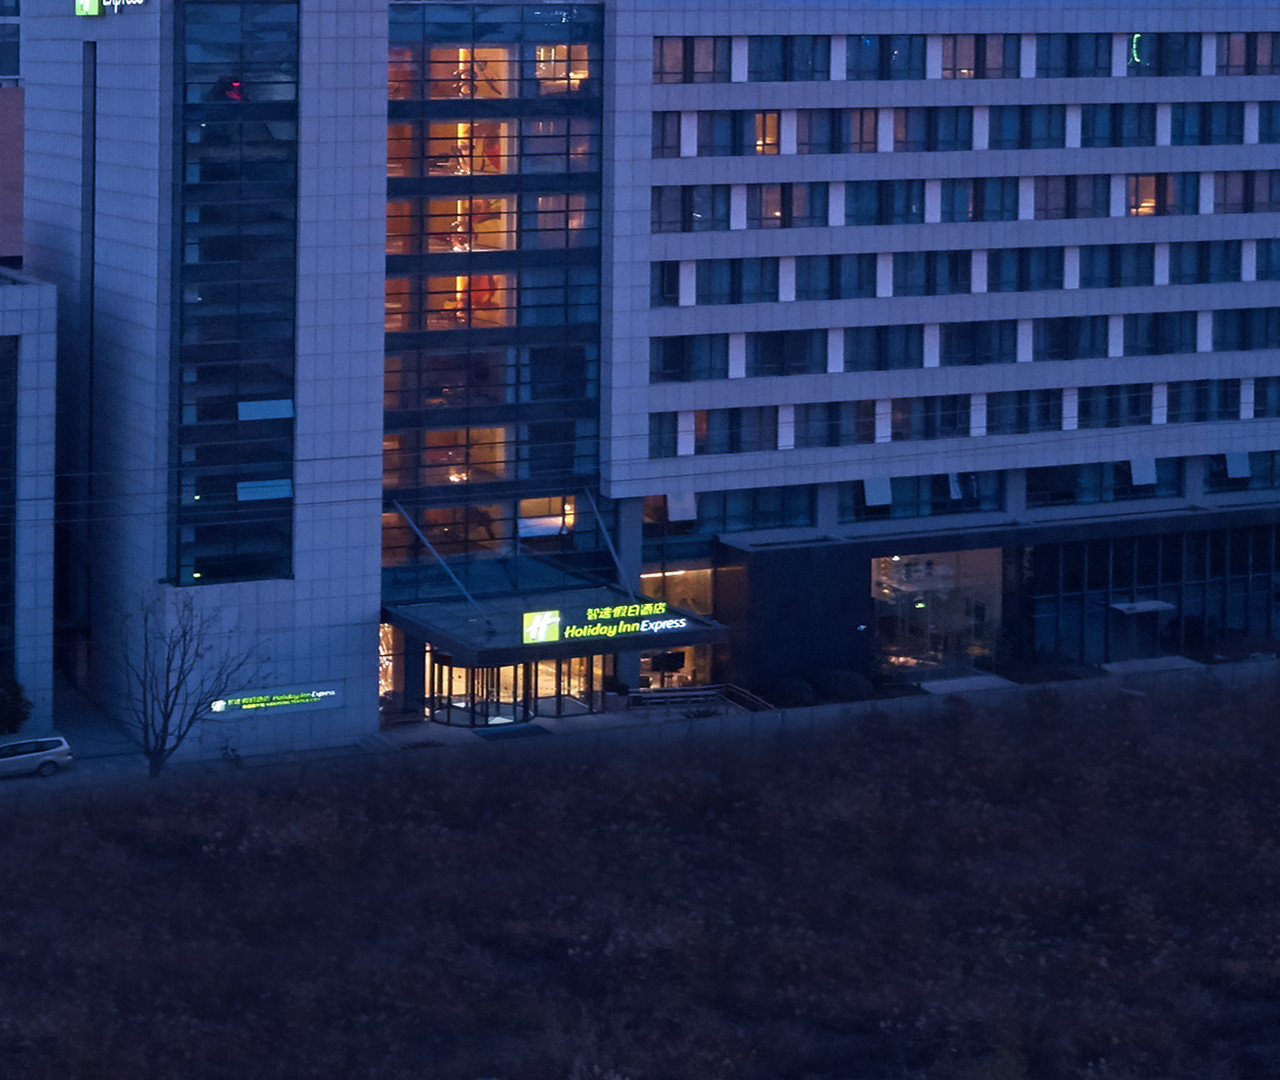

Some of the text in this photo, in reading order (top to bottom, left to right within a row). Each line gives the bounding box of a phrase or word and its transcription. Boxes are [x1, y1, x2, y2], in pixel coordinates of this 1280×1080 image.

[564, 618, 687, 638] Holiday Inn Express
